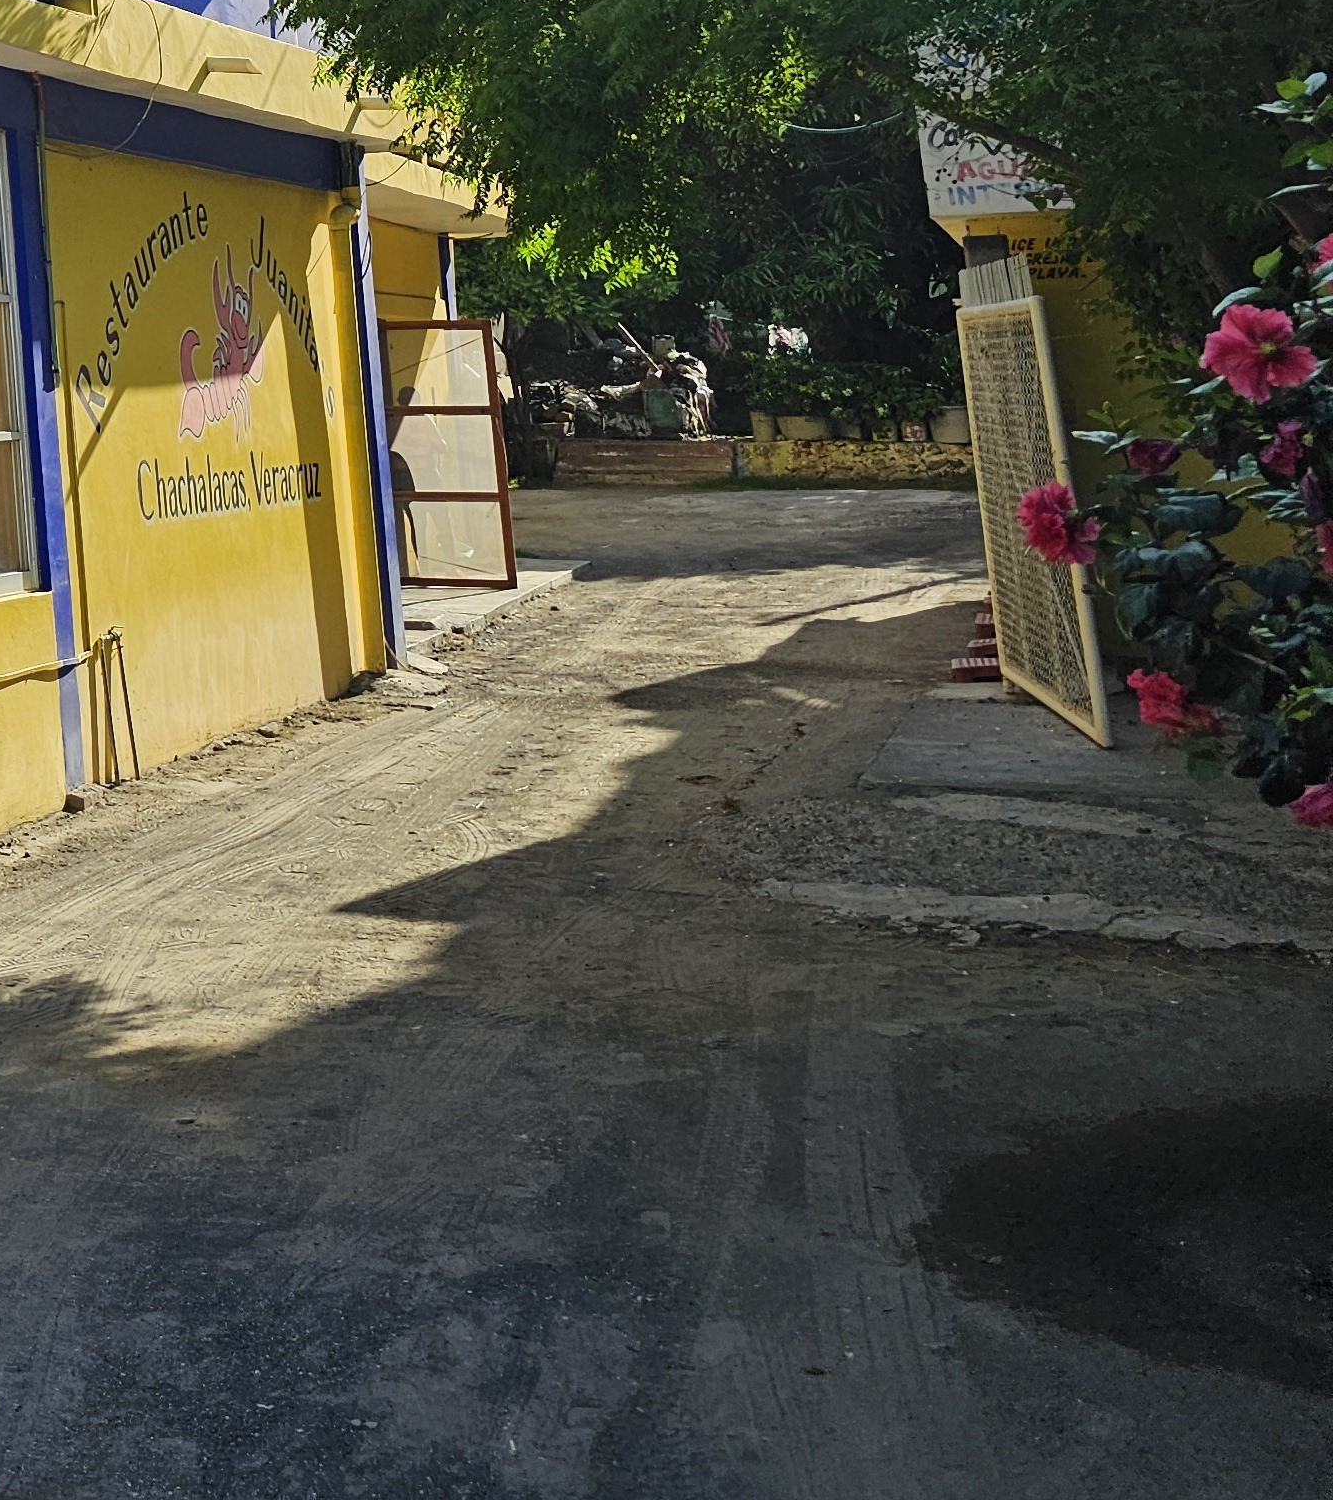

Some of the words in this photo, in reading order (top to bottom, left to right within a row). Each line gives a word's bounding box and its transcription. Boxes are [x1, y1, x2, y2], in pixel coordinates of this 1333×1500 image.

[75, 191, 210, 434] Restaurante
[137, 453, 252, 520] Chachalacas,
[250, 451, 322, 506] Veracruz
